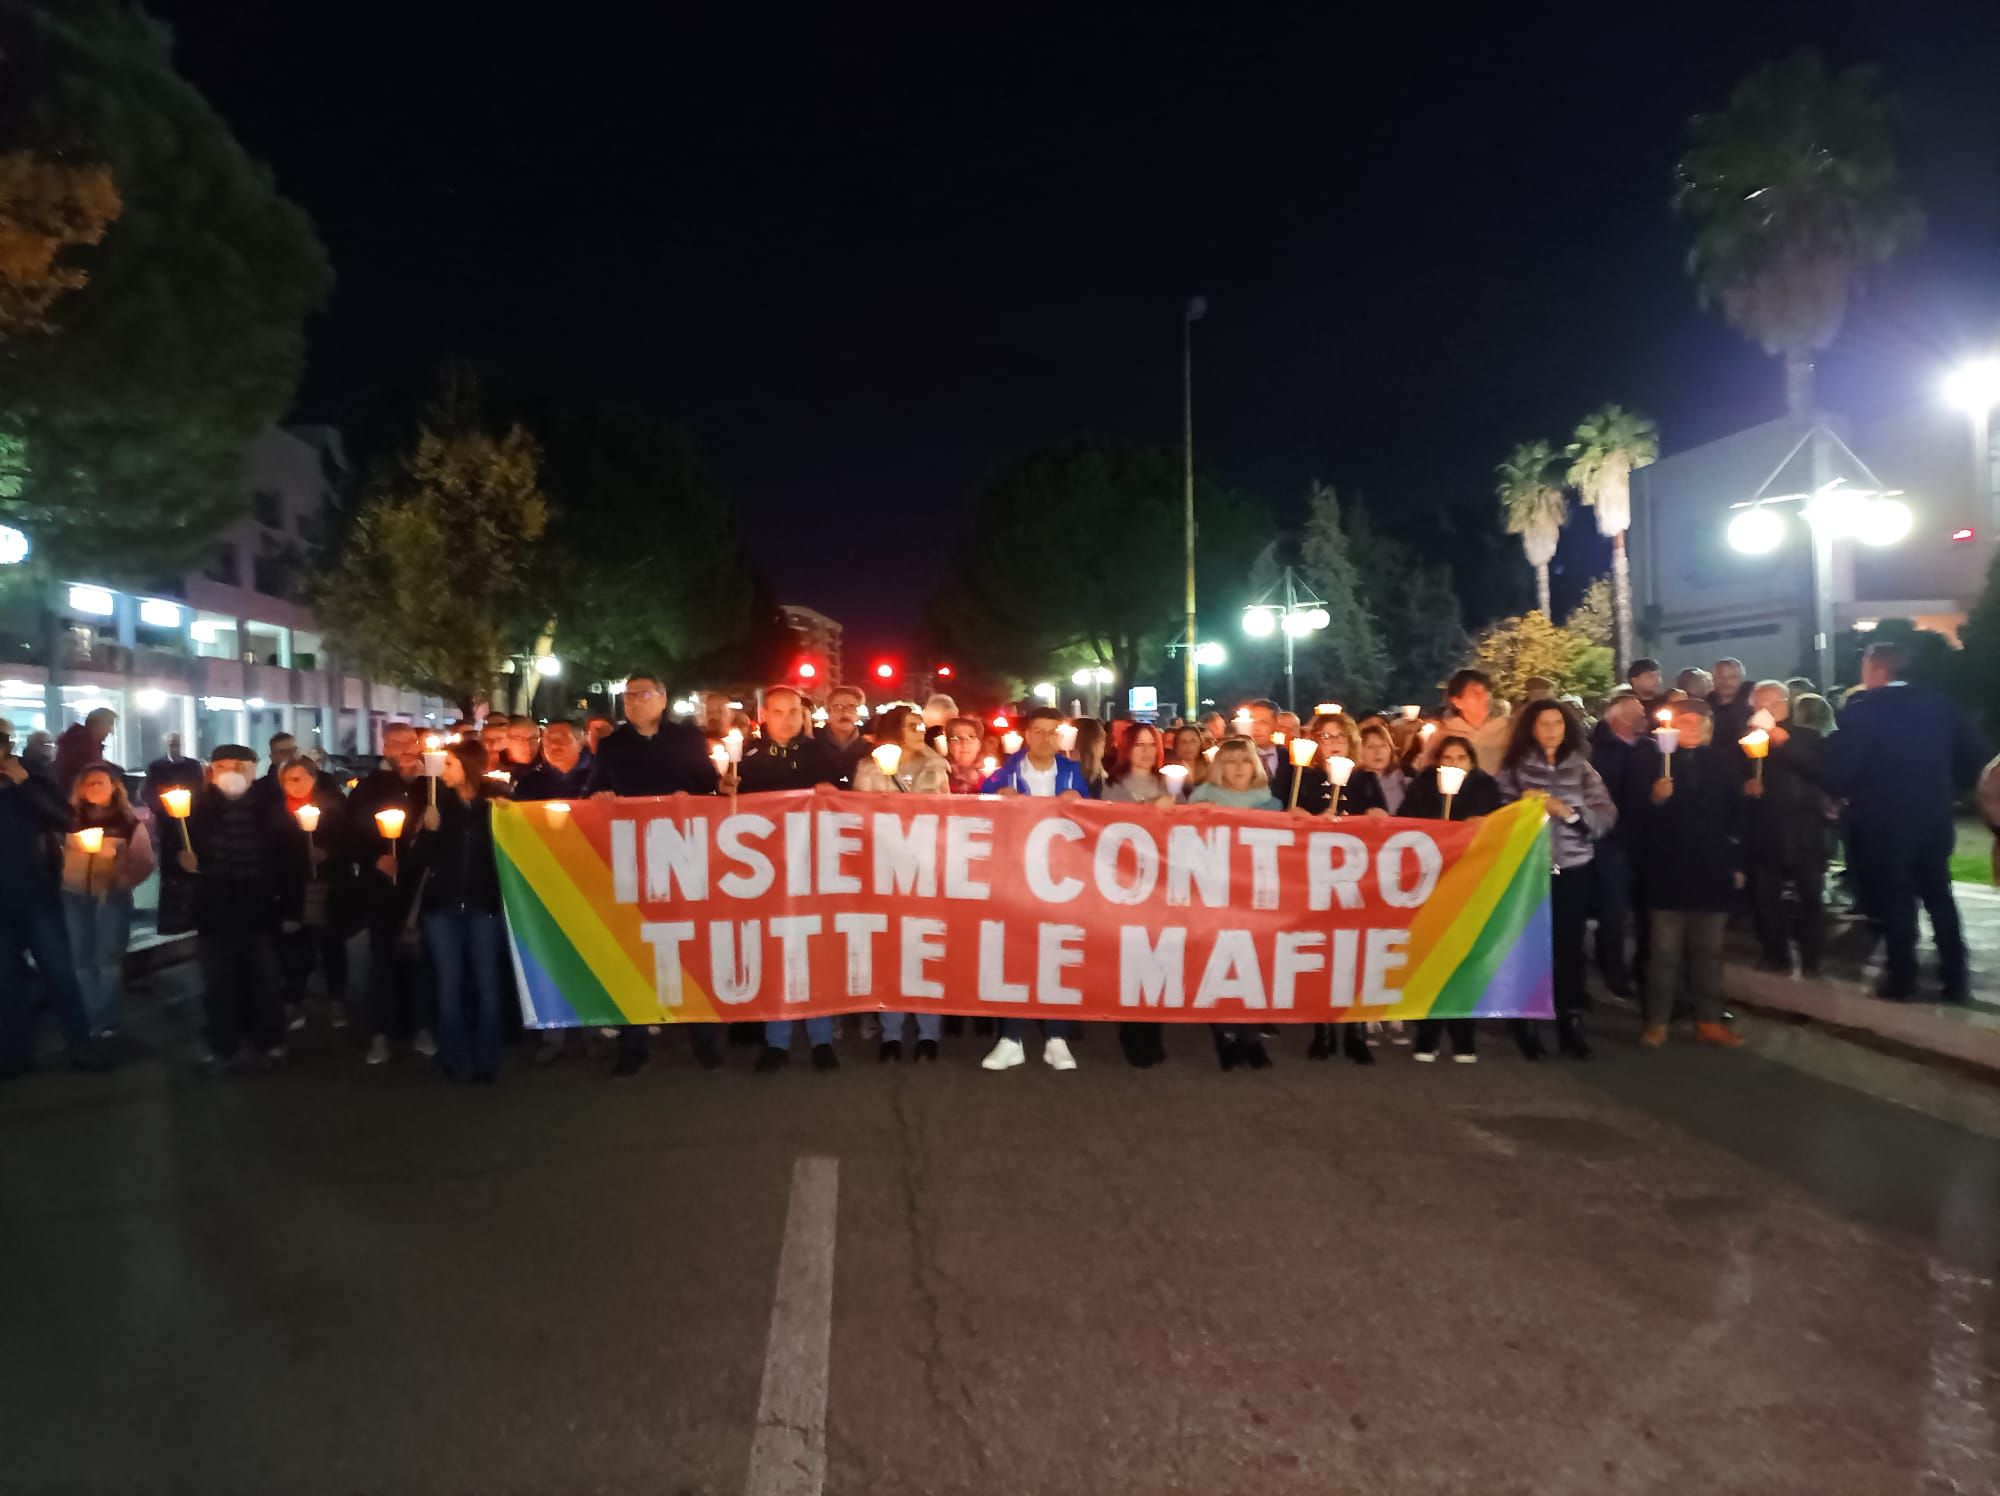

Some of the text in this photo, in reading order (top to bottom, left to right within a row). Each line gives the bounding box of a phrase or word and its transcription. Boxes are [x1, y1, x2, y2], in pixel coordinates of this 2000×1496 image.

[611, 810, 1443, 911] INSIEME CONTRO
[640, 913, 1411, 1009] TUTTE LE MAFIE
